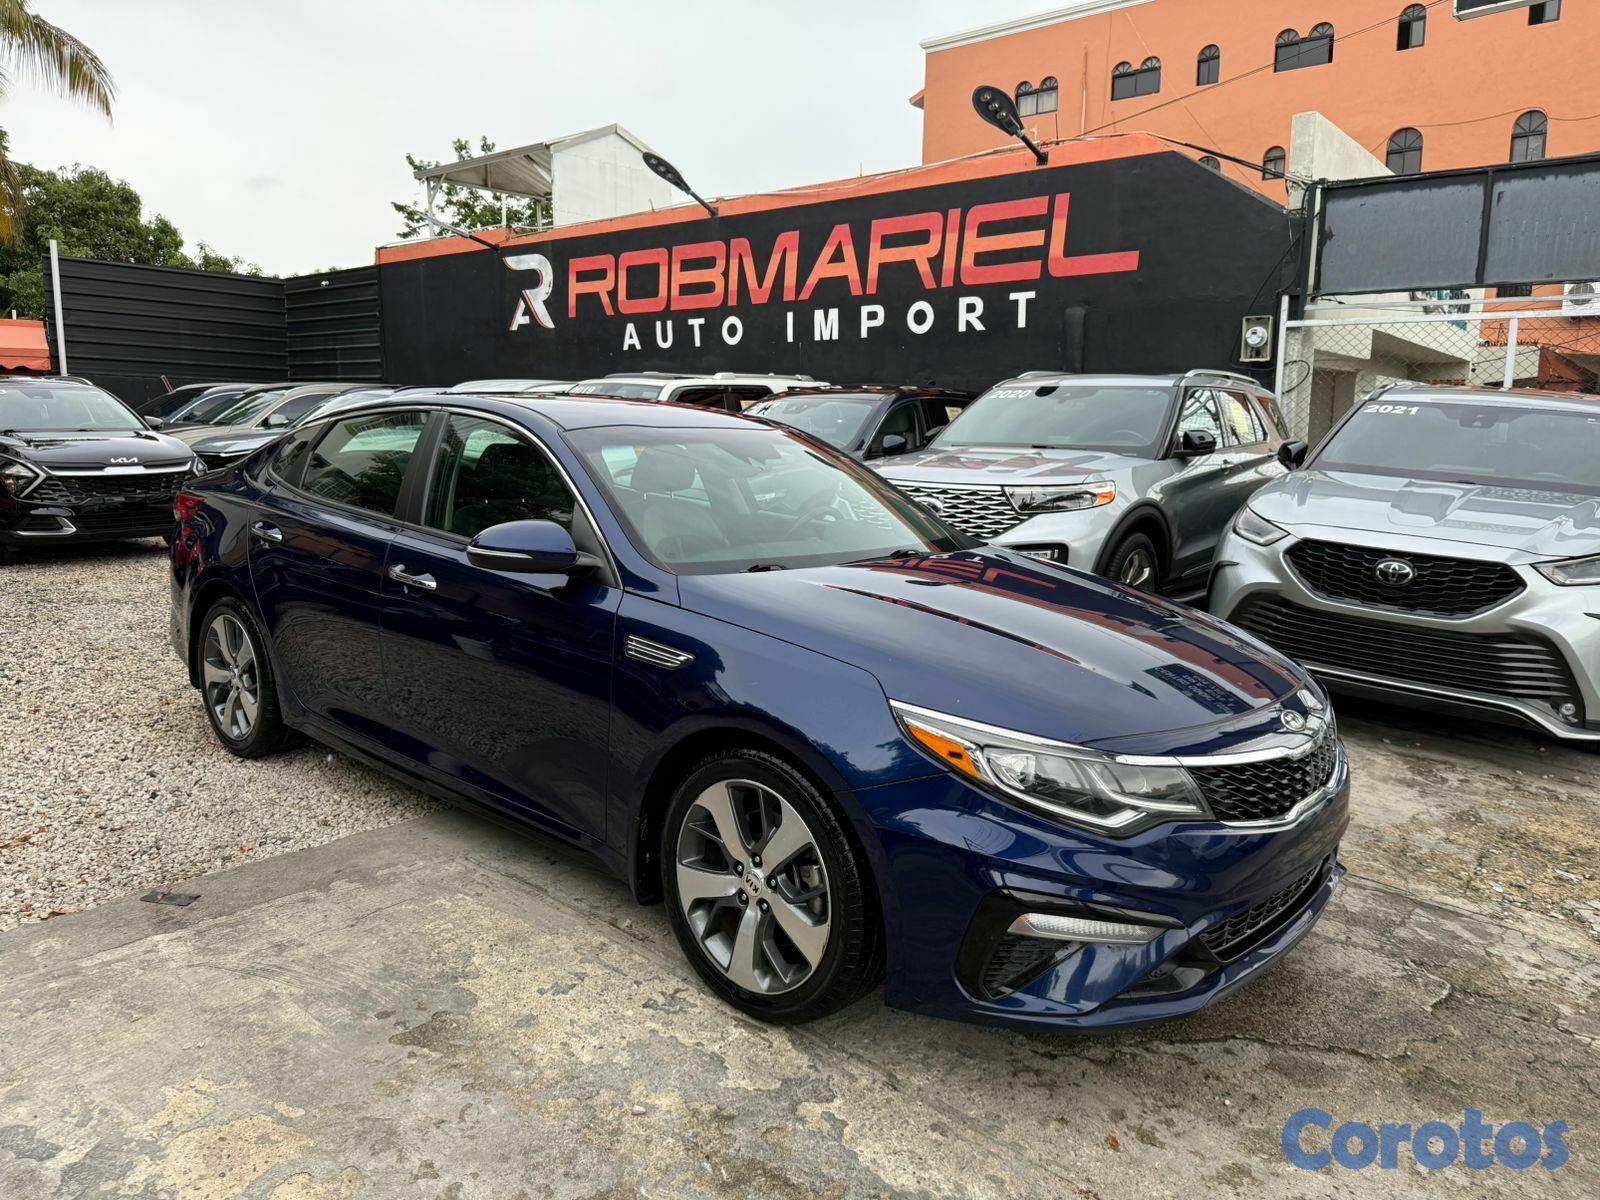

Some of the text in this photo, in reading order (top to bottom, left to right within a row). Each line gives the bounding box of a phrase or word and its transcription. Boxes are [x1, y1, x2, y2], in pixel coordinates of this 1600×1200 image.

[567, 192, 1141, 318] ROBMARIEL
[622, 290, 1036, 352] AUTO IMPORT
[988, 389, 1033, 399] 2020
[1363, 404, 1420, 415] 2021
[745, 875, 759, 893] KIA
